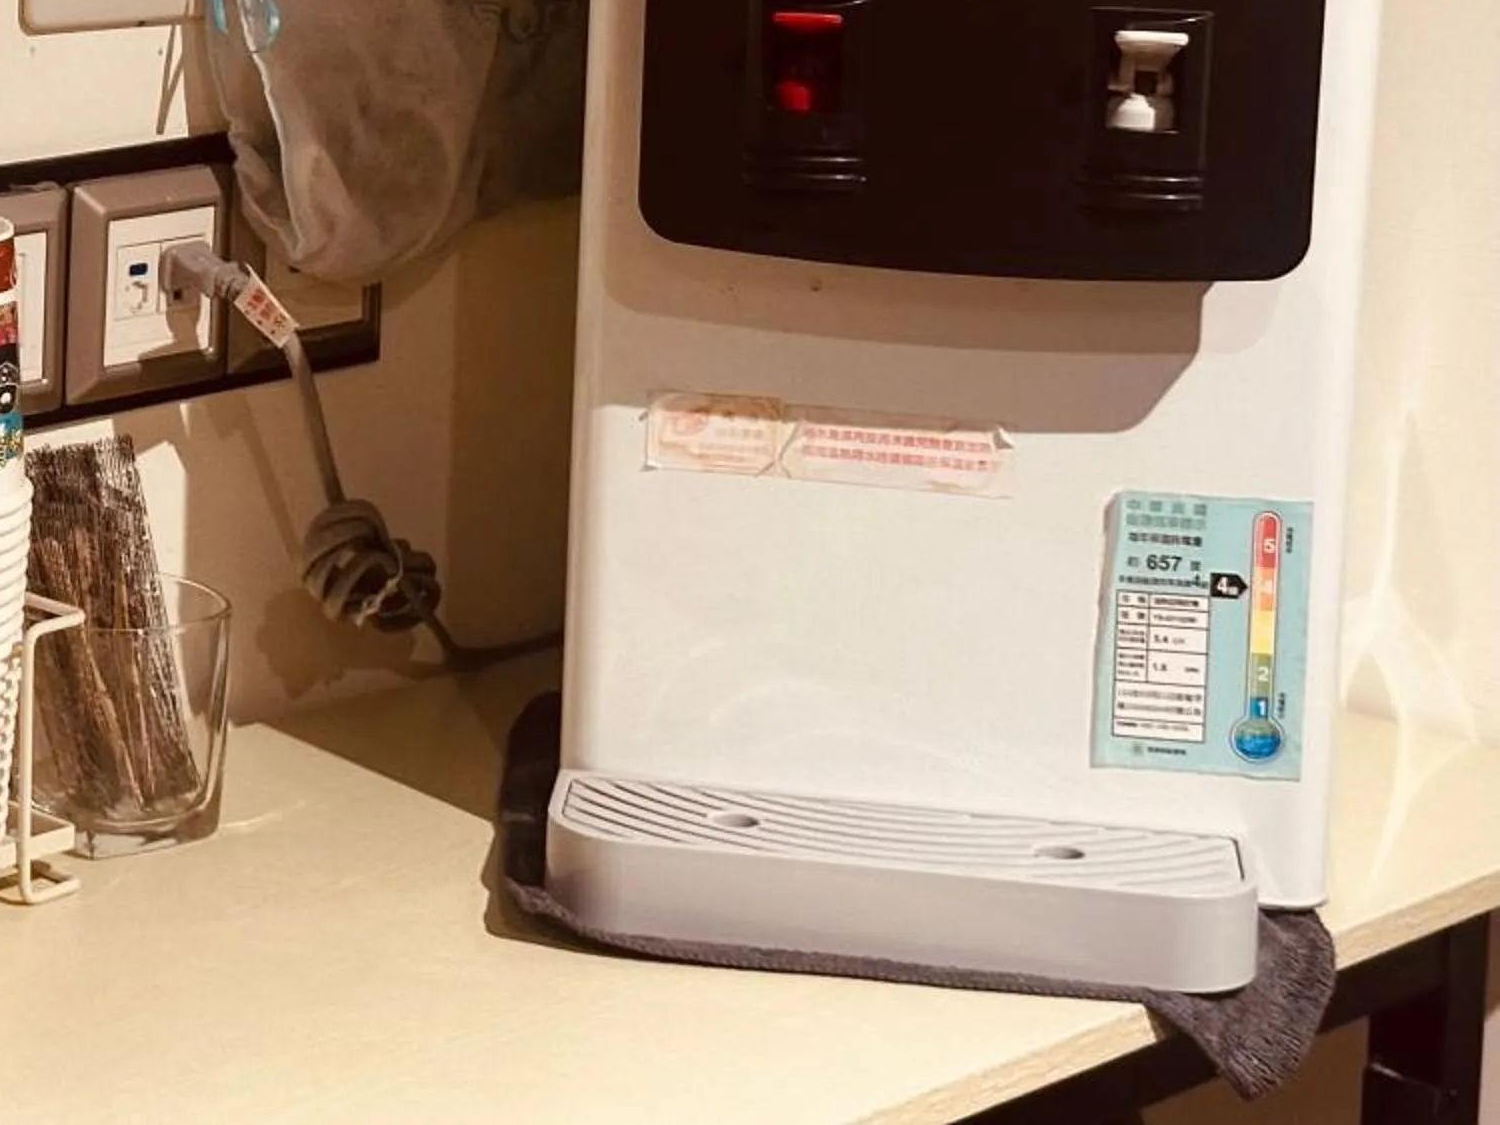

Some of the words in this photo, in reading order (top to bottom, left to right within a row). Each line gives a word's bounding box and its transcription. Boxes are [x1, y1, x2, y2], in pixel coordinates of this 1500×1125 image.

[1263, 537, 1276, 553] 5
[1146, 553, 1183, 572] 657
[1256, 666, 1269, 682] 2
